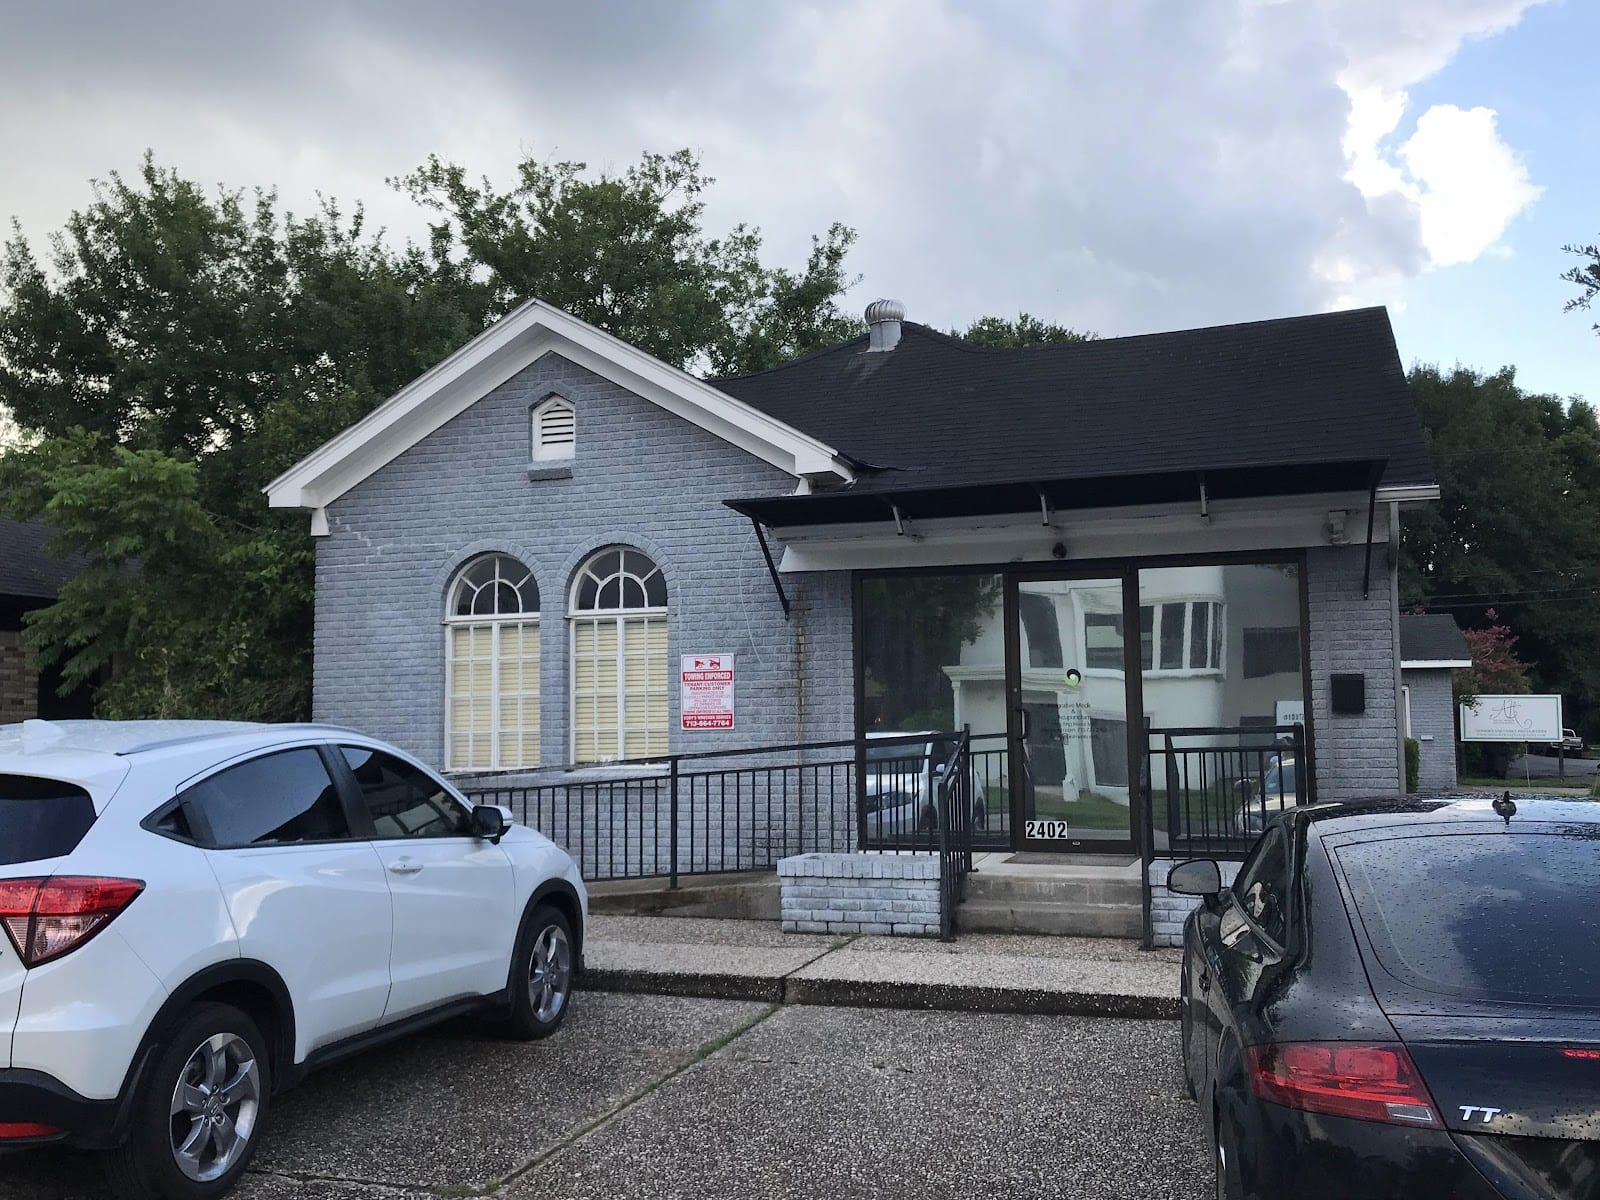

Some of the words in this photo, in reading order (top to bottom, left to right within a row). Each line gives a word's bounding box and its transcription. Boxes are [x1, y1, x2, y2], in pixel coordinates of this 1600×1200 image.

[705, 672, 731, 680] ENFORCED
[1026, 821, 1066, 838] 2402
[1459, 1105, 1501, 1123] TT
